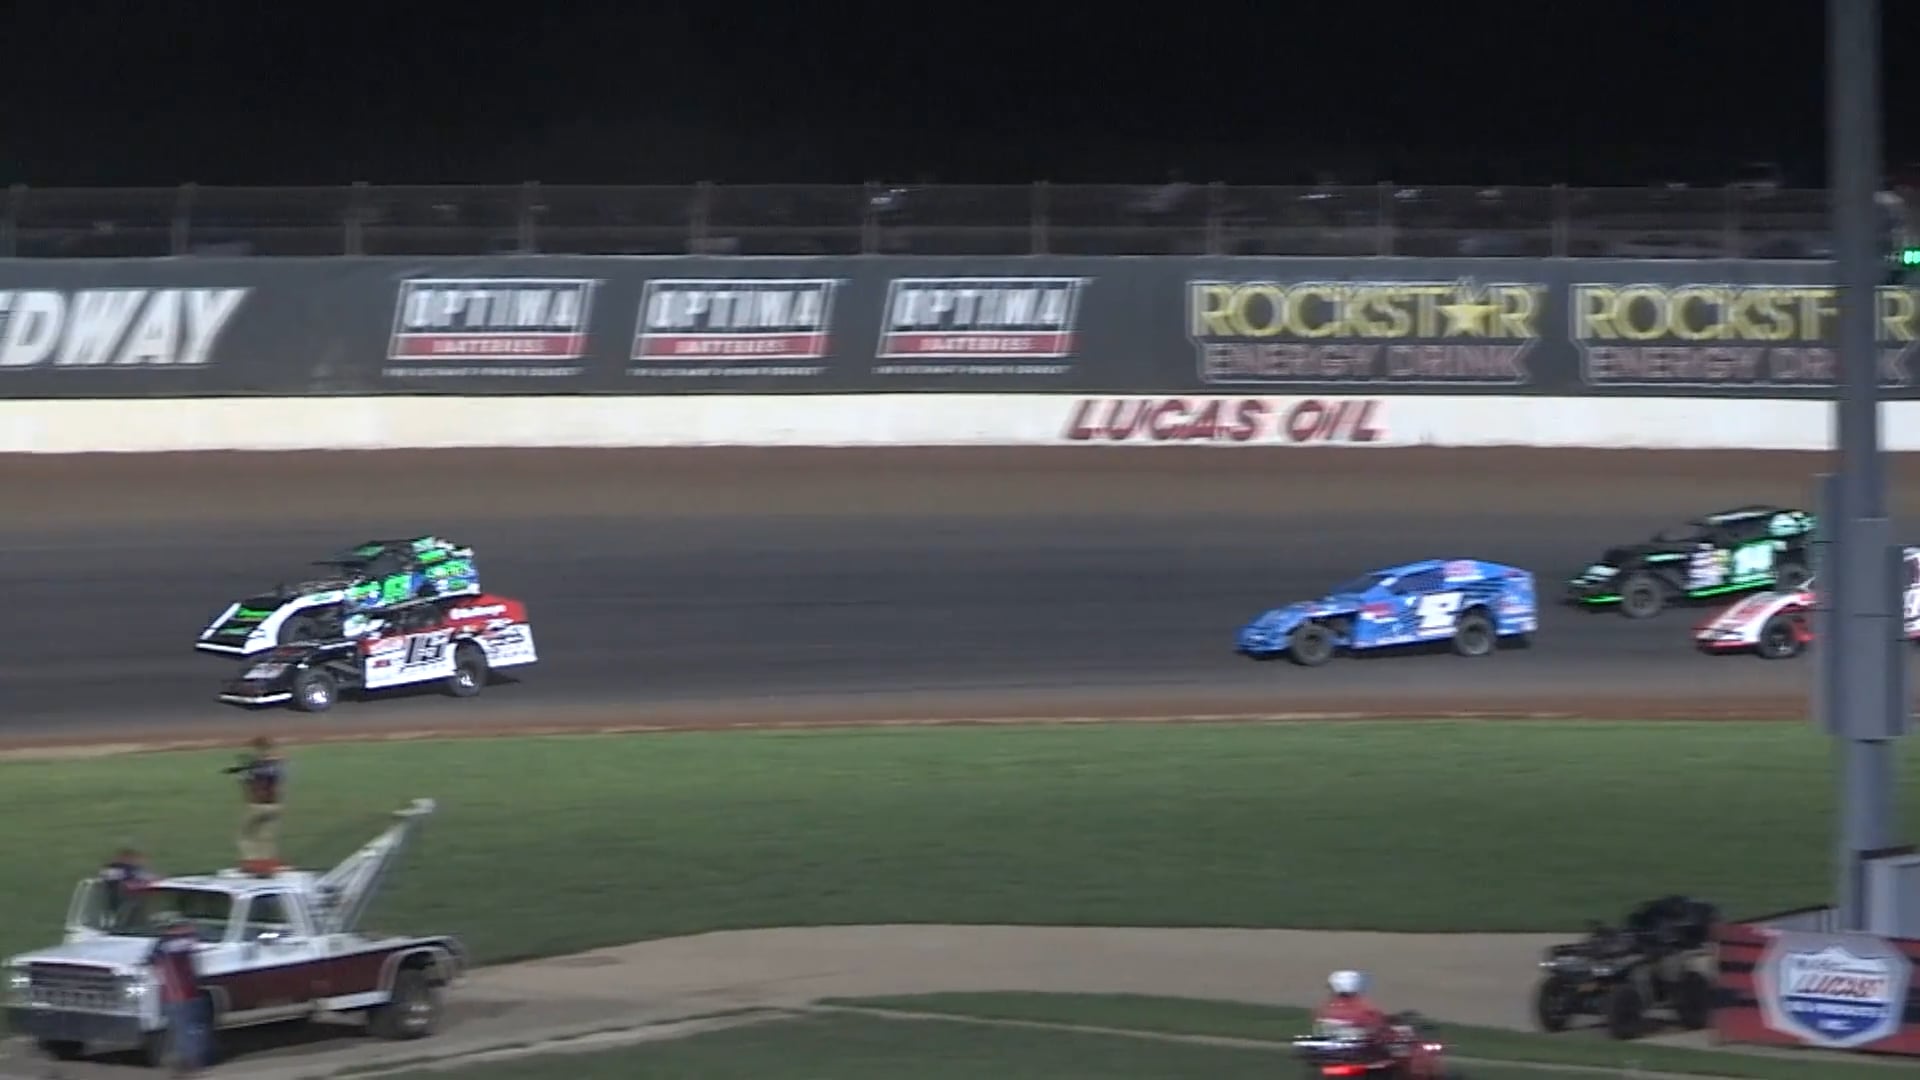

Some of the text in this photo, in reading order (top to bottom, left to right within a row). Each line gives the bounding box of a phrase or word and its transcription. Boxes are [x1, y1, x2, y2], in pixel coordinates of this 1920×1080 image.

[404, 288, 582, 328] OPTIMA
[647, 289, 825, 329] OPTIMA
[891, 287, 1070, 327] OPTIMA
[0, 288, 250, 368] DWAY
[1065, 399, 1384, 442] LUCAS OIL
